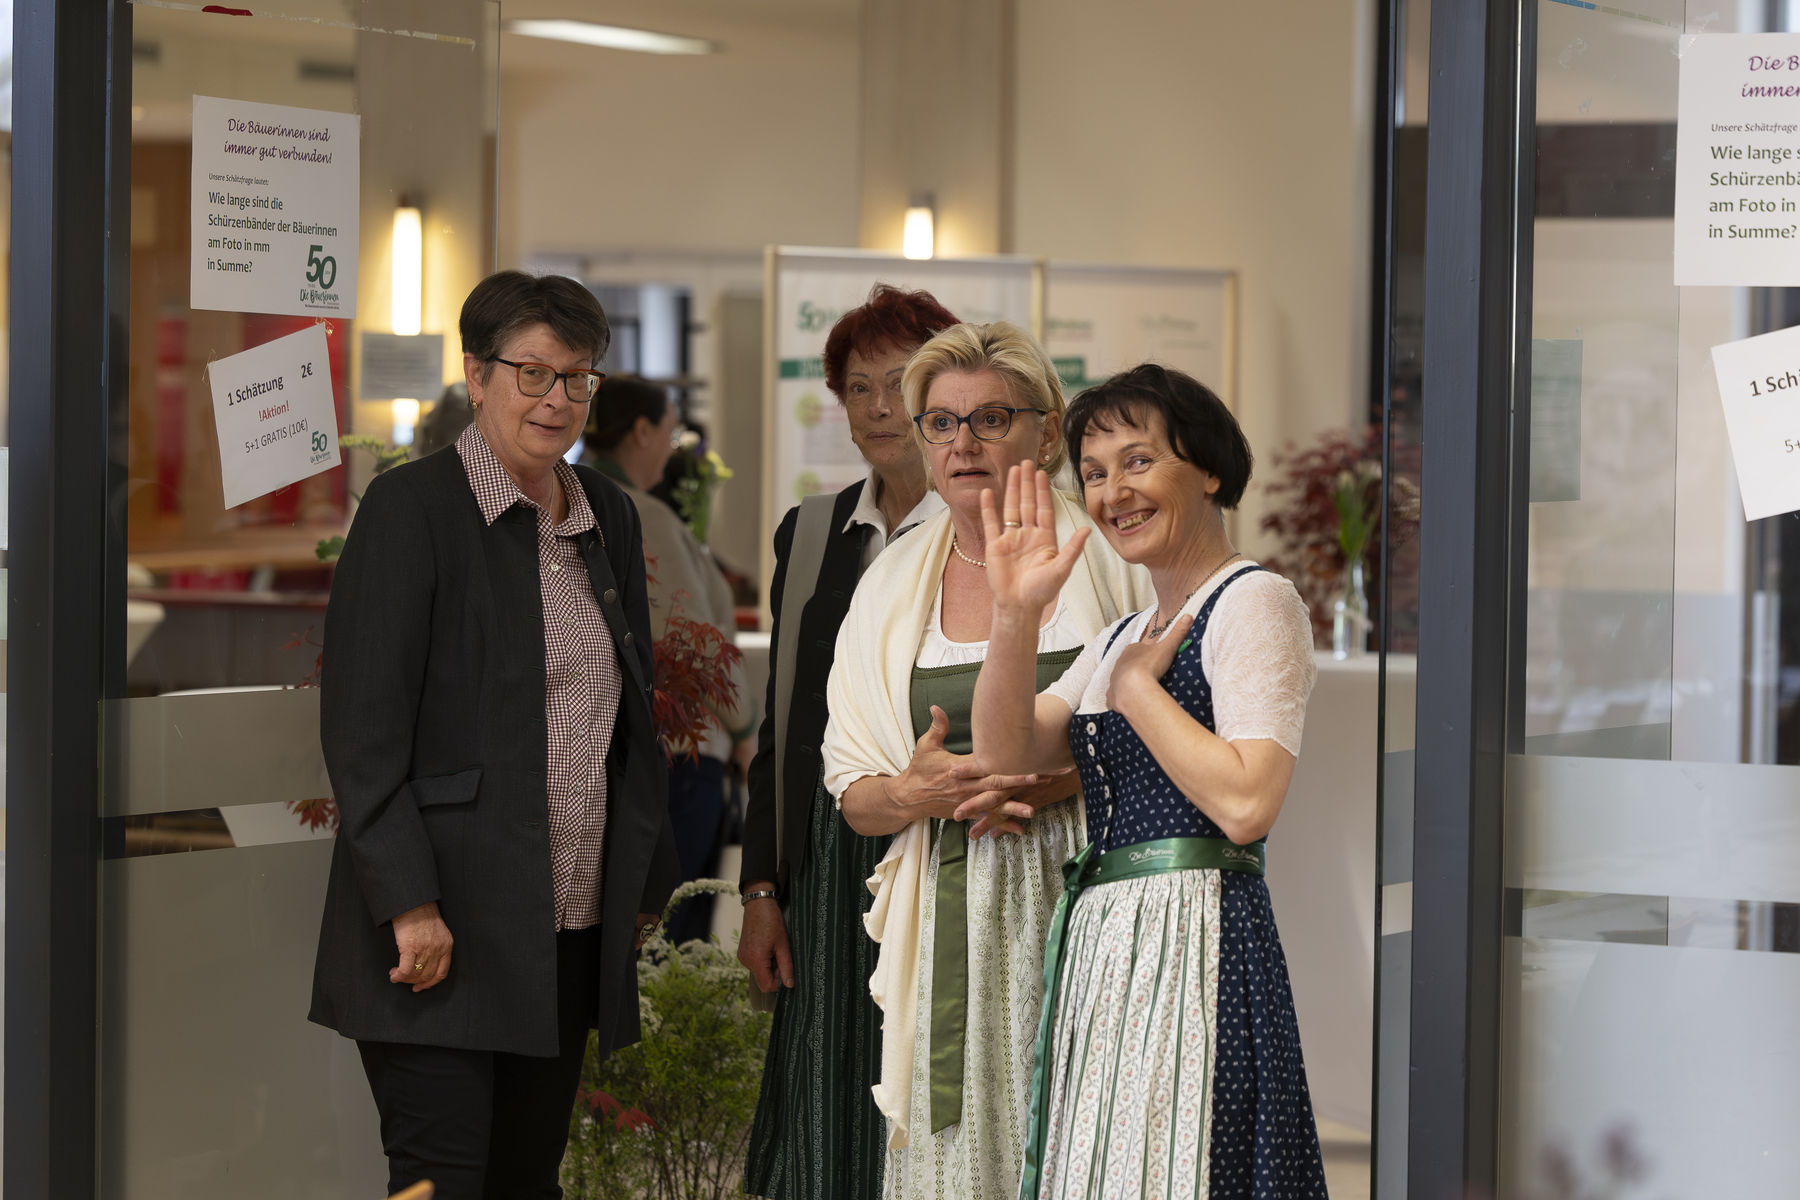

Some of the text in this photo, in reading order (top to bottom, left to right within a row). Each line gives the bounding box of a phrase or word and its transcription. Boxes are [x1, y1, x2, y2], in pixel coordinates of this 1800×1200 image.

[1748, 55, 1785, 71] Die
[228, 118, 331, 143] Die Bäuerinnen sind
[1711, 122, 1798, 134] Unsere Schätzfrage
[224, 140, 332, 164] immer gut verbunden!
[1710, 146, 1743, 160] Wie
[1747, 145, 1792, 165] lange
[208, 191, 284, 211] Wie lange sind die
[1709, 197, 1796, 213] am Foto in
[208, 213, 338, 238] Schürzenbänder der Bäuerinnen
[1708, 224, 1797, 239] in Summe?
[207, 237, 270, 253] am Foto in mm
[207, 257, 253, 273] in Summe?
[305, 244, 337, 290] 50
[301, 362, 313, 379] 2€
[227, 376, 284, 406] 1 Schätzung
[1750, 369, 1800, 397] 1 Sch
[258, 400, 290, 422] !Aktion!
[245, 417, 309, 454] 5+1 GRATIS (10€)
[311, 430, 328, 452] 50
